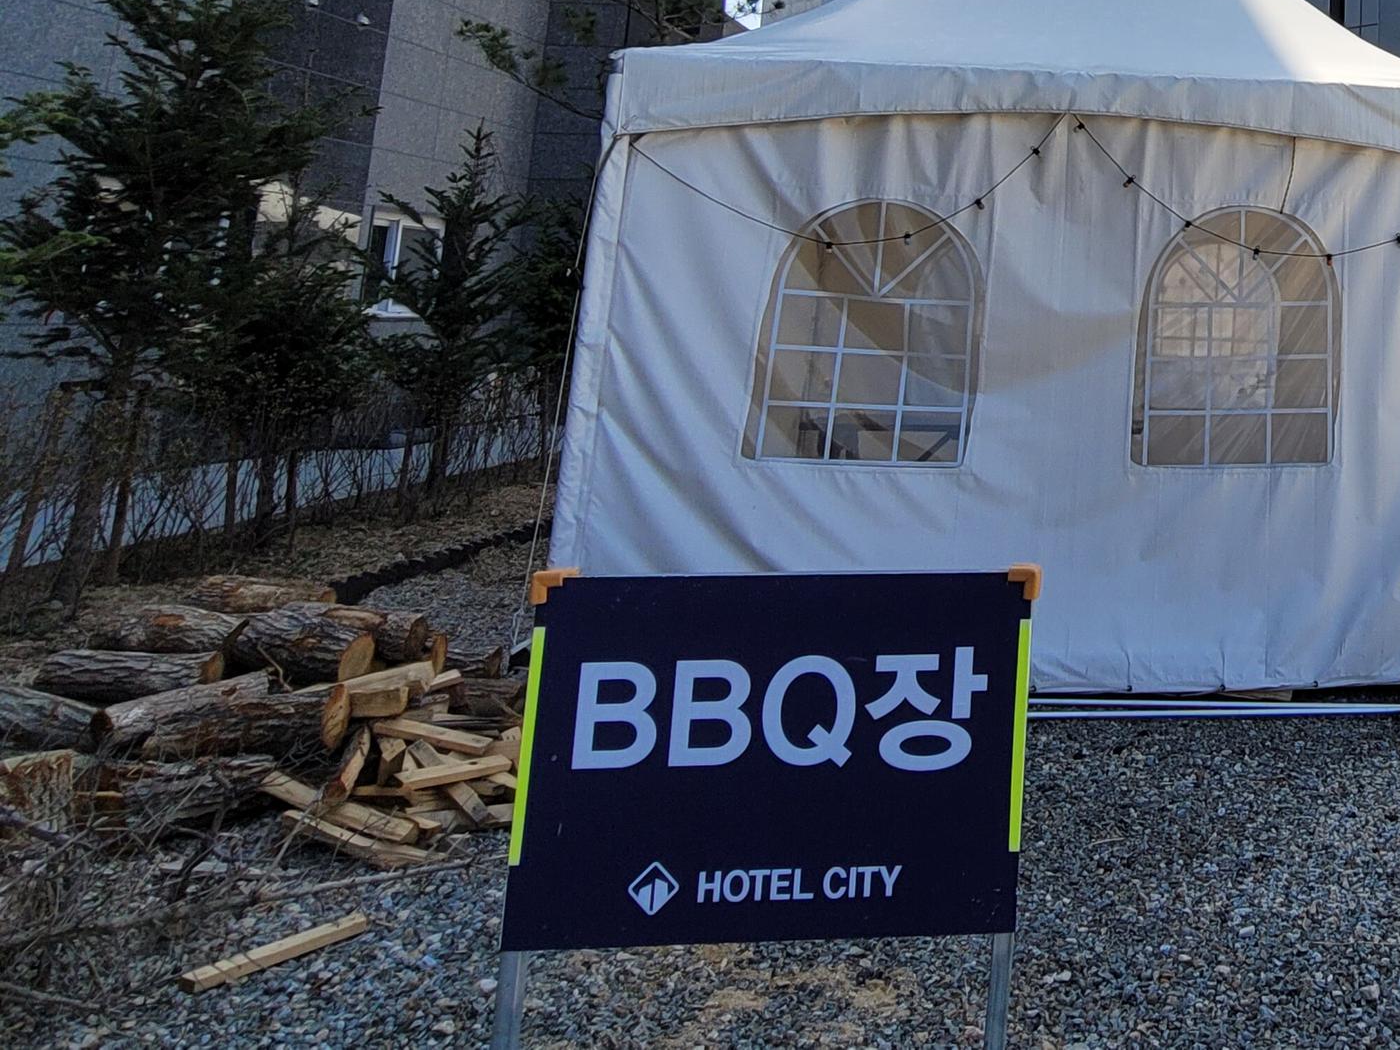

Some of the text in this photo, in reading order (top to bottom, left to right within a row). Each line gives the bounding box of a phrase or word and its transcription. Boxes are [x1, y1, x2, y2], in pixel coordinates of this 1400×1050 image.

[570, 645, 989, 773] BBQ장
[696, 865, 903, 904] HOTEL CITY
